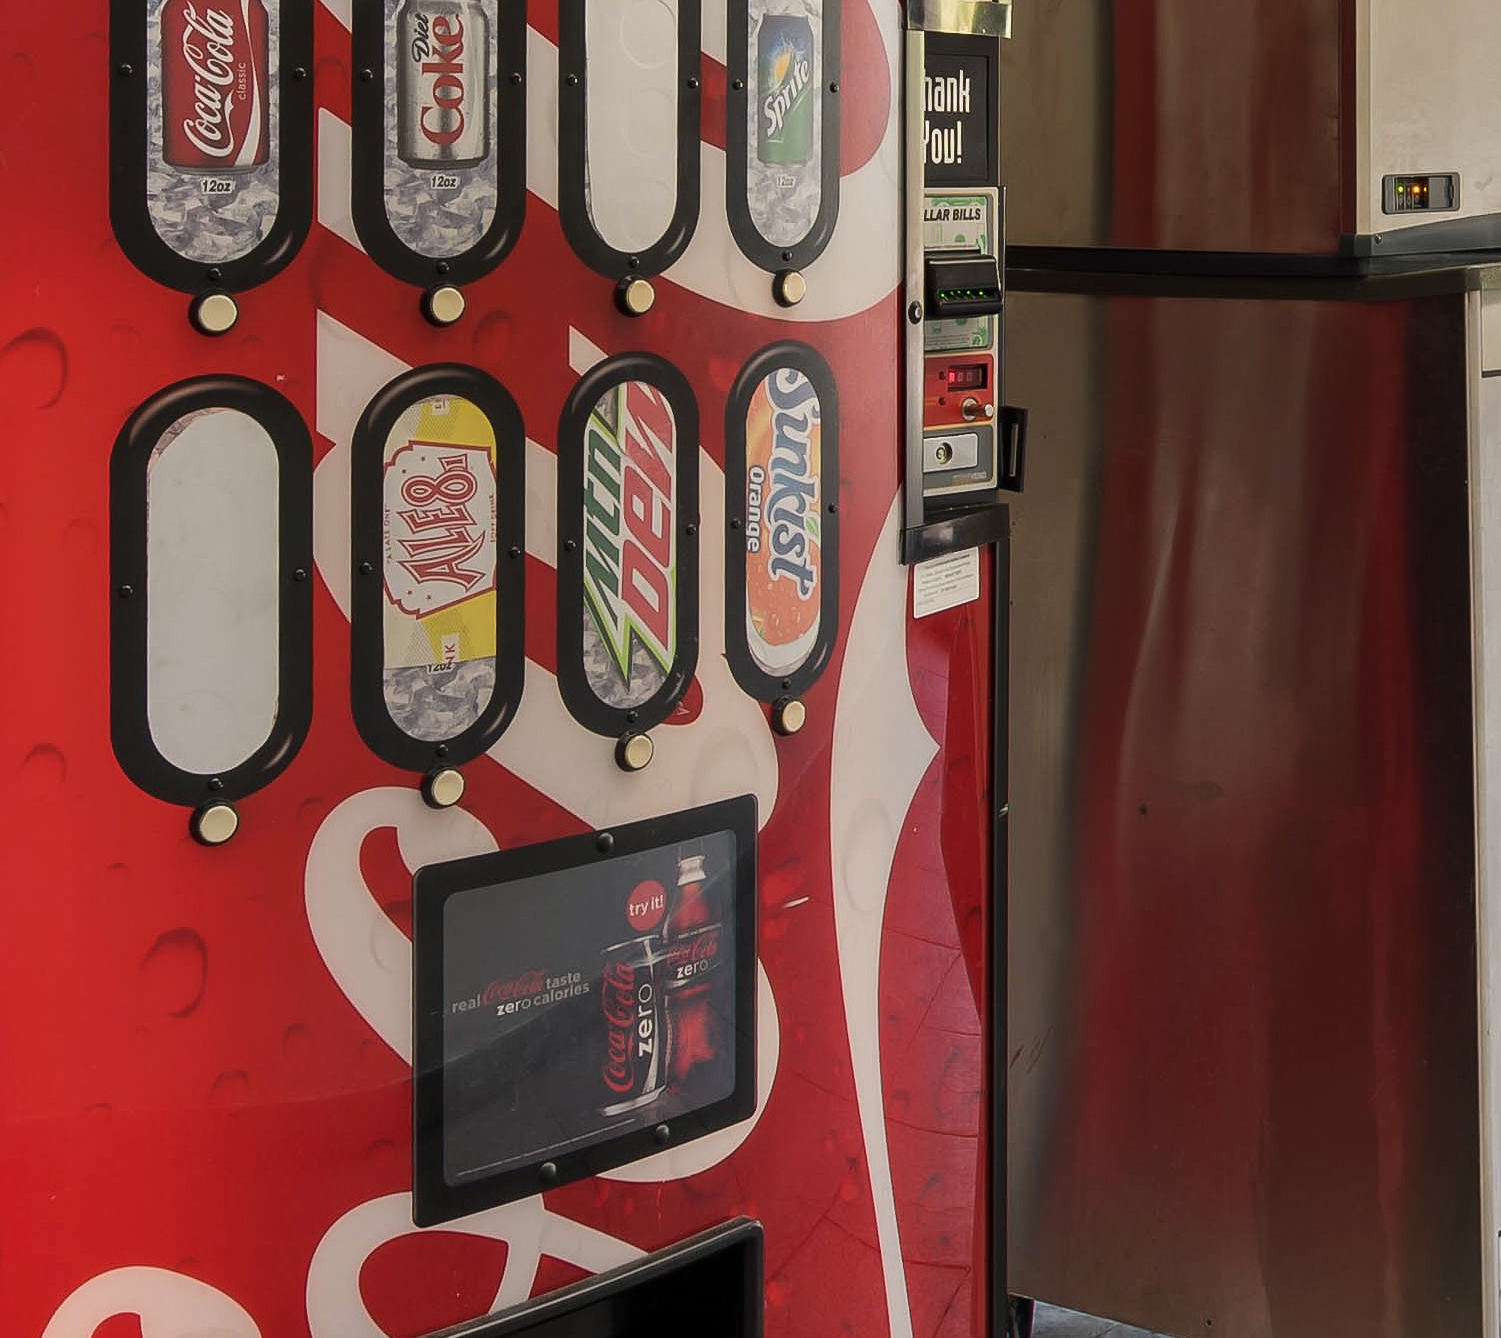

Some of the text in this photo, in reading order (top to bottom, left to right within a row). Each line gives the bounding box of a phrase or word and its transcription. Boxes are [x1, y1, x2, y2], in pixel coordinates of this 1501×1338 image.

[412, 13, 431, 62] Diet
[183, 0, 235, 159] Coca-Cola
[236, 62, 247, 101] classic
[420, 14, 465, 146] Coke
[763, 56, 811, 140] Sprite
[202, 179, 232, 194] 12oz
[430, 175, 458, 189] 12oz
[953, 207, 981, 220] BILLS
[766, 367, 821, 600] Sunkist
[748, 466, 766, 553] Orange
[628, 894, 665, 918] try it!
[676, 958, 708, 979] zero
[452, 994, 481, 1014] real
[545, 971, 582, 990] taste
[497, 981, 590, 1017] zero calories
[638, 983, 653, 1059] zero
